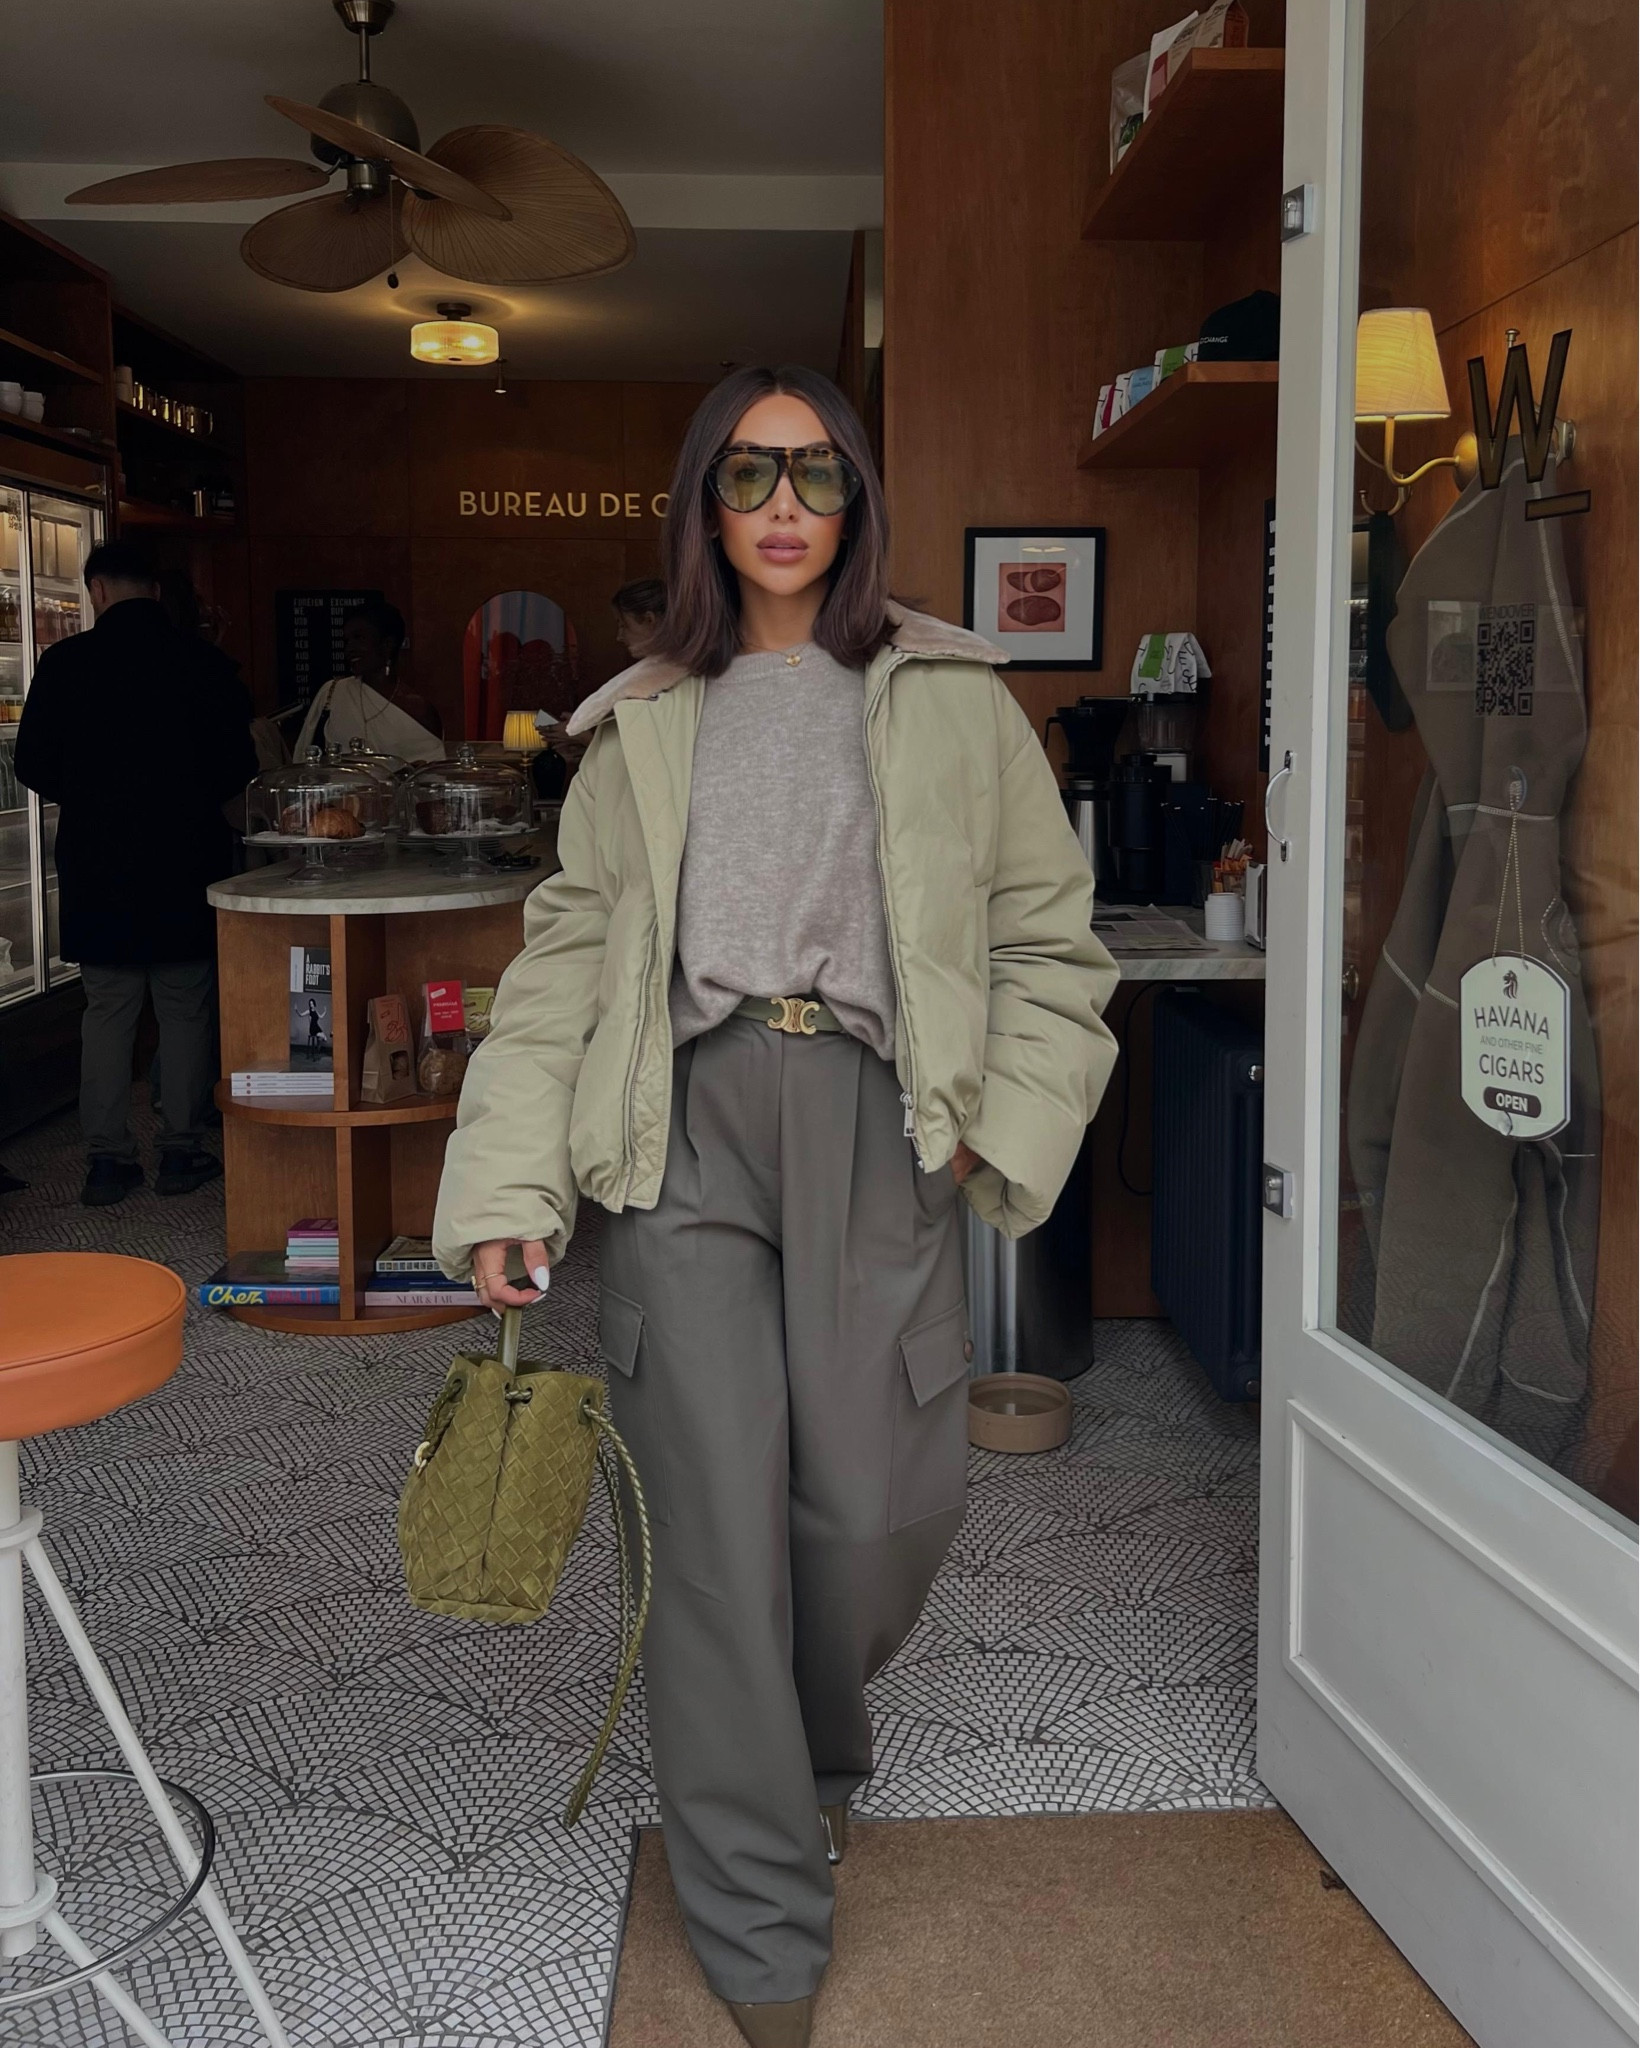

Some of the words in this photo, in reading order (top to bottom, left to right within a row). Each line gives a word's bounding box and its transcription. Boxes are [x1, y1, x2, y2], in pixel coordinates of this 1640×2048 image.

[1467, 329, 1573, 490] W
[460, 491, 587, 518] BUREAU
[600, 493, 642, 518] DE
[1480, 603, 1536, 619] WENDOVER
[306, 953, 310, 963] A
[306, 963, 331, 976] RABBIT'S
[306, 974, 319, 986] FOOT
[1474, 1005, 1550, 1040] HAVANA
[1480, 1035, 1497, 1048] AND
[1498, 1037, 1523, 1052] OTHER
[1525, 1042, 1543, 1055] FINE
[1479, 1053, 1545, 1085] CIGARS
[1495, 1092, 1529, 1113] OPEN
[208, 1286, 264, 1305] Chez
[397, 1295, 423, 1304] NEAR
[425, 1295, 432, 1304] &
[434, 1295, 453, 1304] FAR
